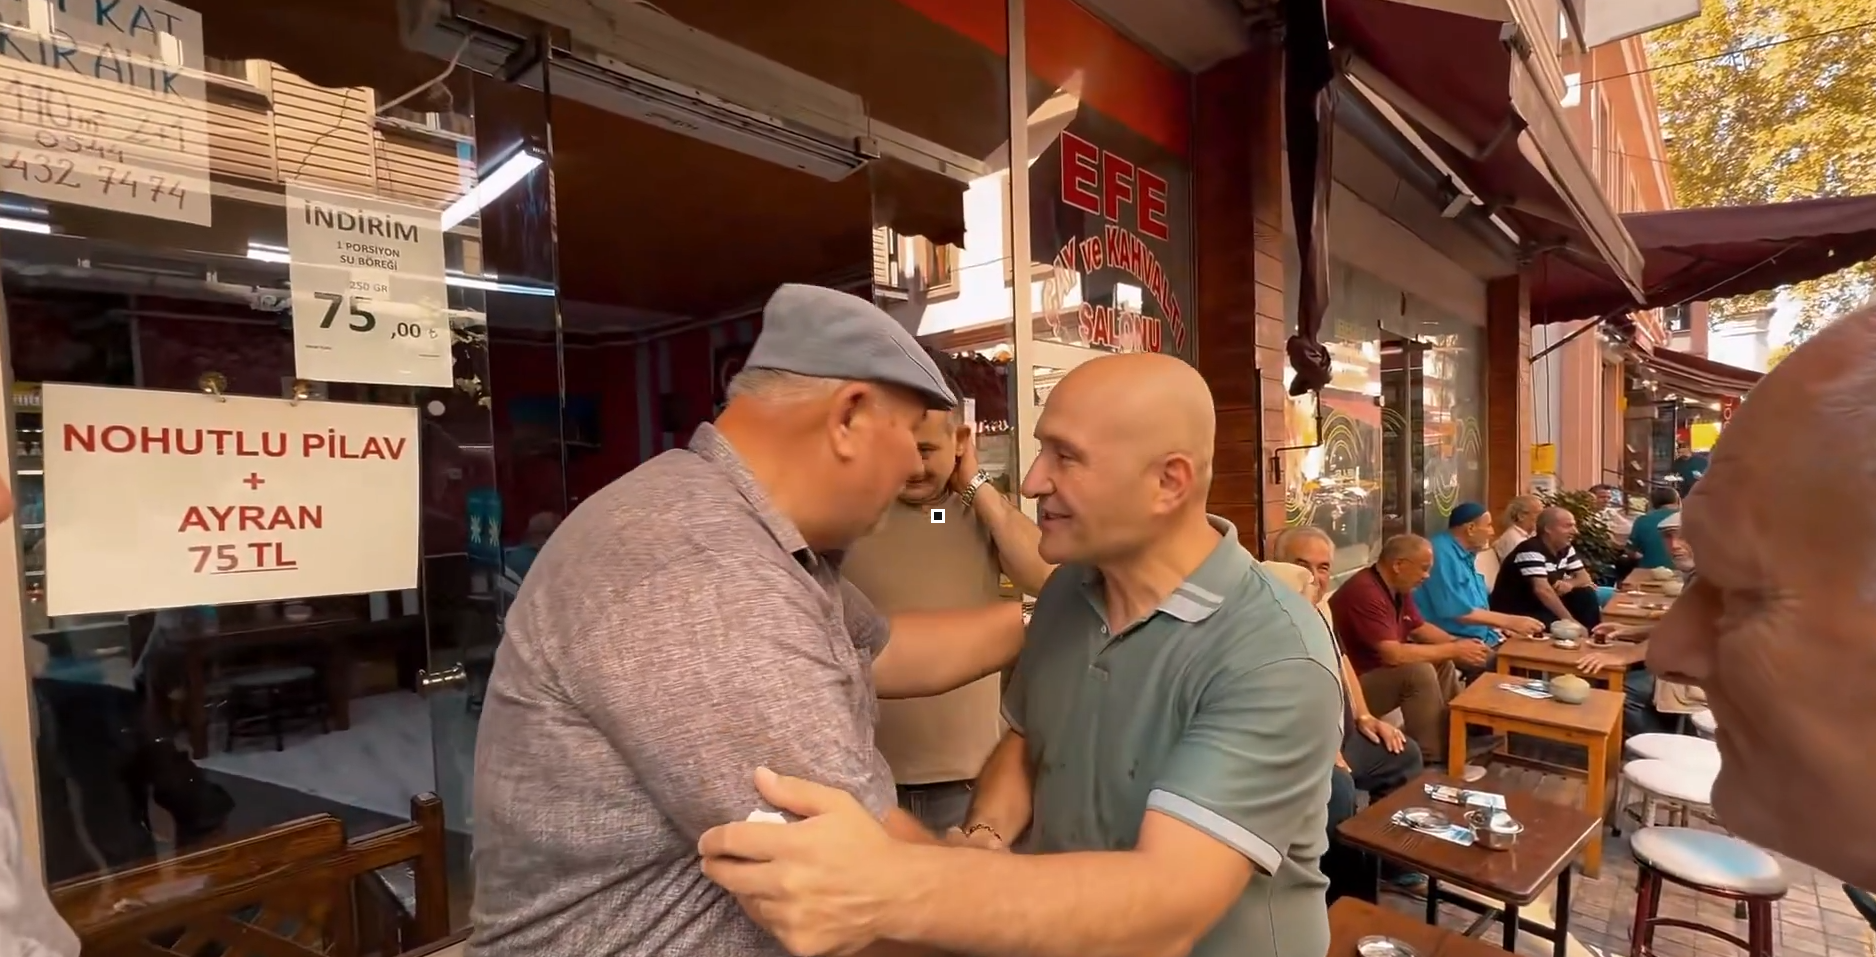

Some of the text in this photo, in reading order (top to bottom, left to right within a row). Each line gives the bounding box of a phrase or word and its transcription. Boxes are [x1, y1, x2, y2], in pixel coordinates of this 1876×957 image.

[96, 0, 182, 45] KAT
[3, 151, 186, 210] 432 74 74
[1060, 128, 1169, 241] EFE
[305, 200, 418, 243] İNDİRİM
[337, 241, 342, 249] 1
[340, 254, 398, 271] SU BÖREĞİ
[349, 281, 388, 293] 250 GR
[1079, 235, 1104, 275] ve
[1104, 223, 1187, 352] KAHVALTI
[314, 291, 376, 332] 75
[1078, 301, 1162, 353] SALONU
[63, 423, 406, 460] NOHUTLU PİLAV
[178, 505, 323, 532] AYRAN
[188, 541, 297, 573] 75 TL
